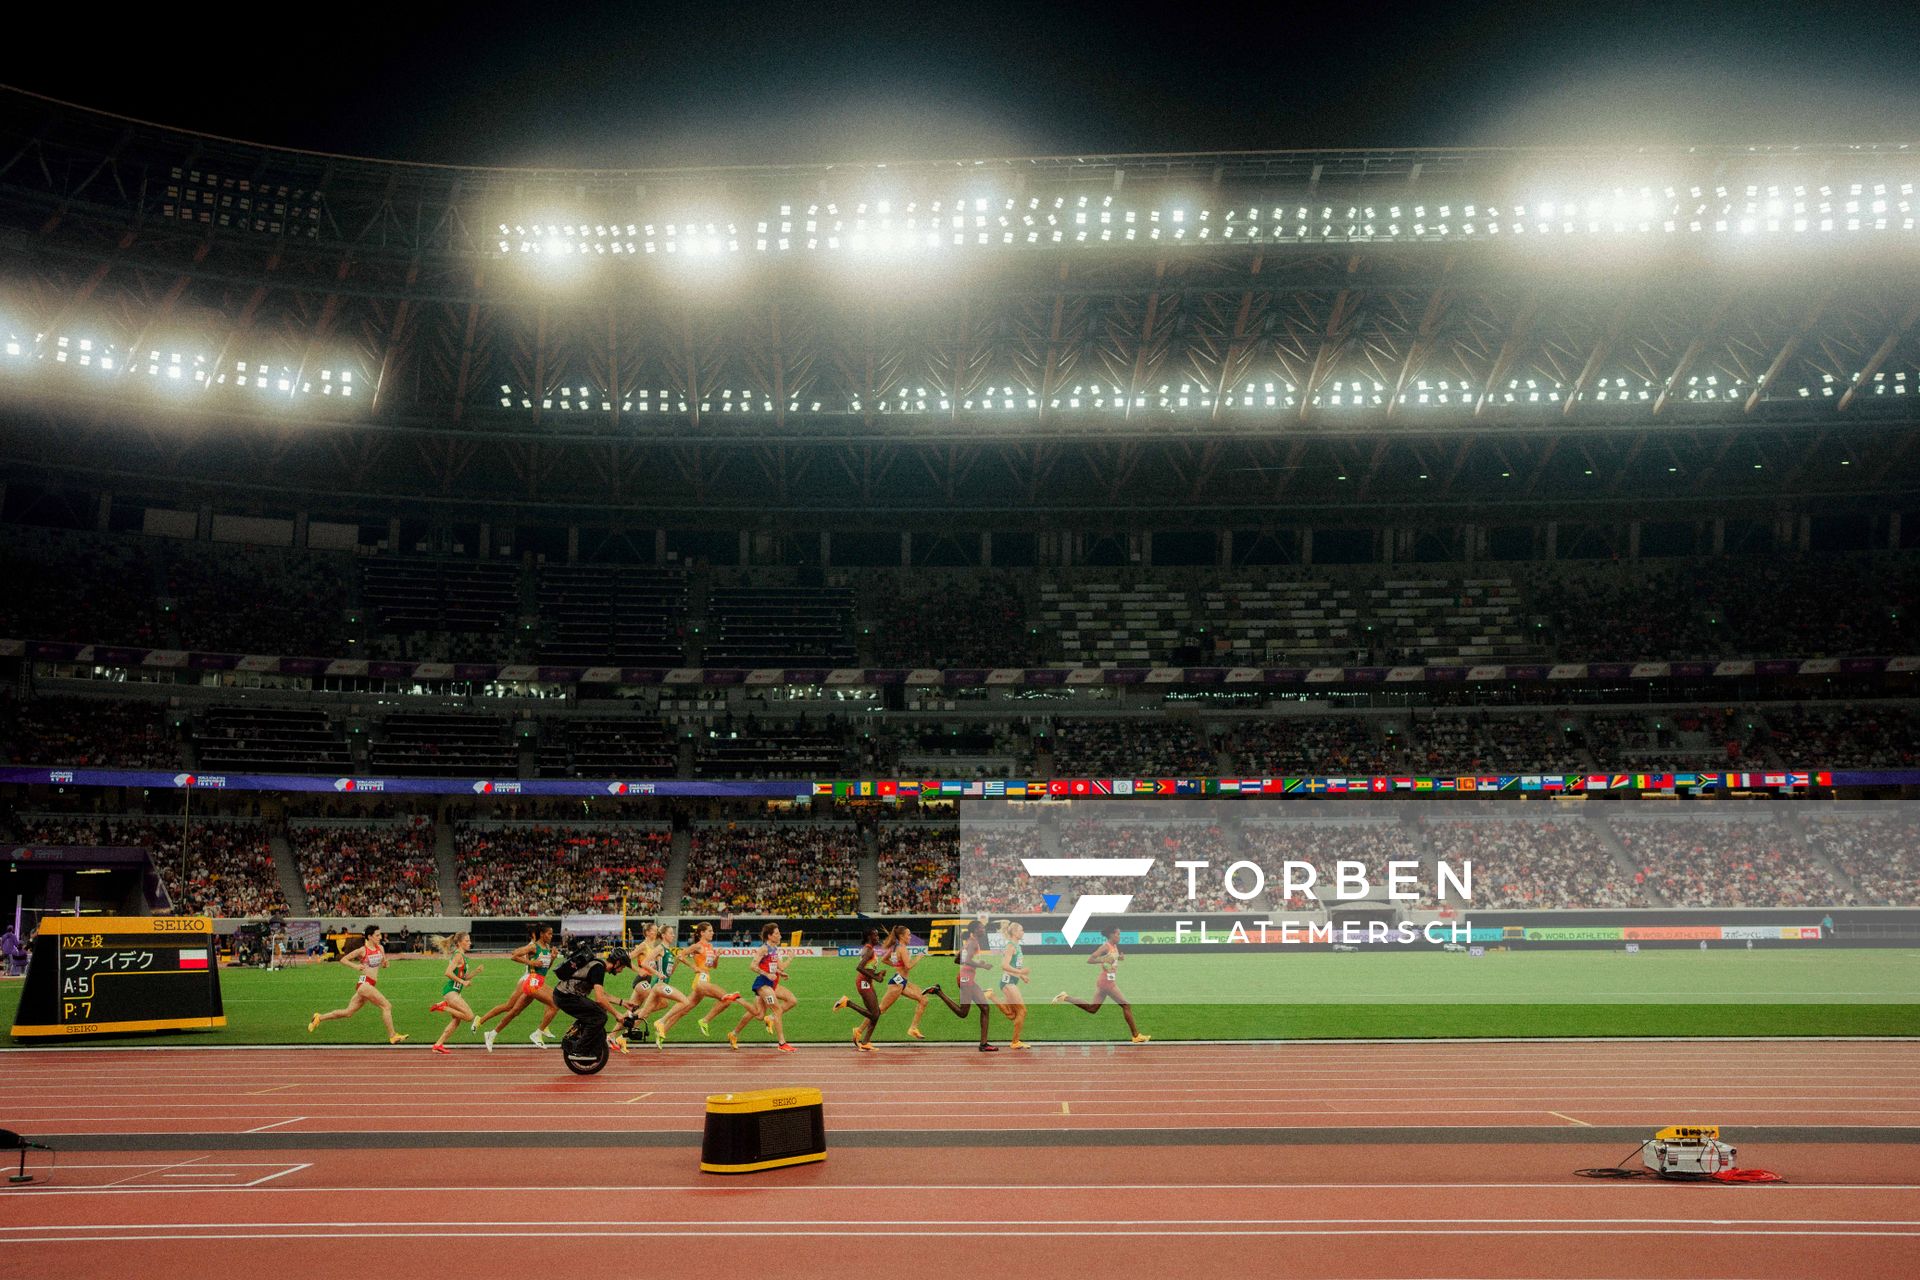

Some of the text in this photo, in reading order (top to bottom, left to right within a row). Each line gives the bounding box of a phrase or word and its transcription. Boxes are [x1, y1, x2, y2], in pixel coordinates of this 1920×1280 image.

[153, 919, 205, 931] SEIKO
[1576, 931, 1619, 939] ATHLETICS
[1471, 948, 1482, 956] 70
[65, 951, 154, 971] ファイデク
[66, 1024, 98, 1034] SEIKO
[772, 1097, 797, 1107] SEIKO
